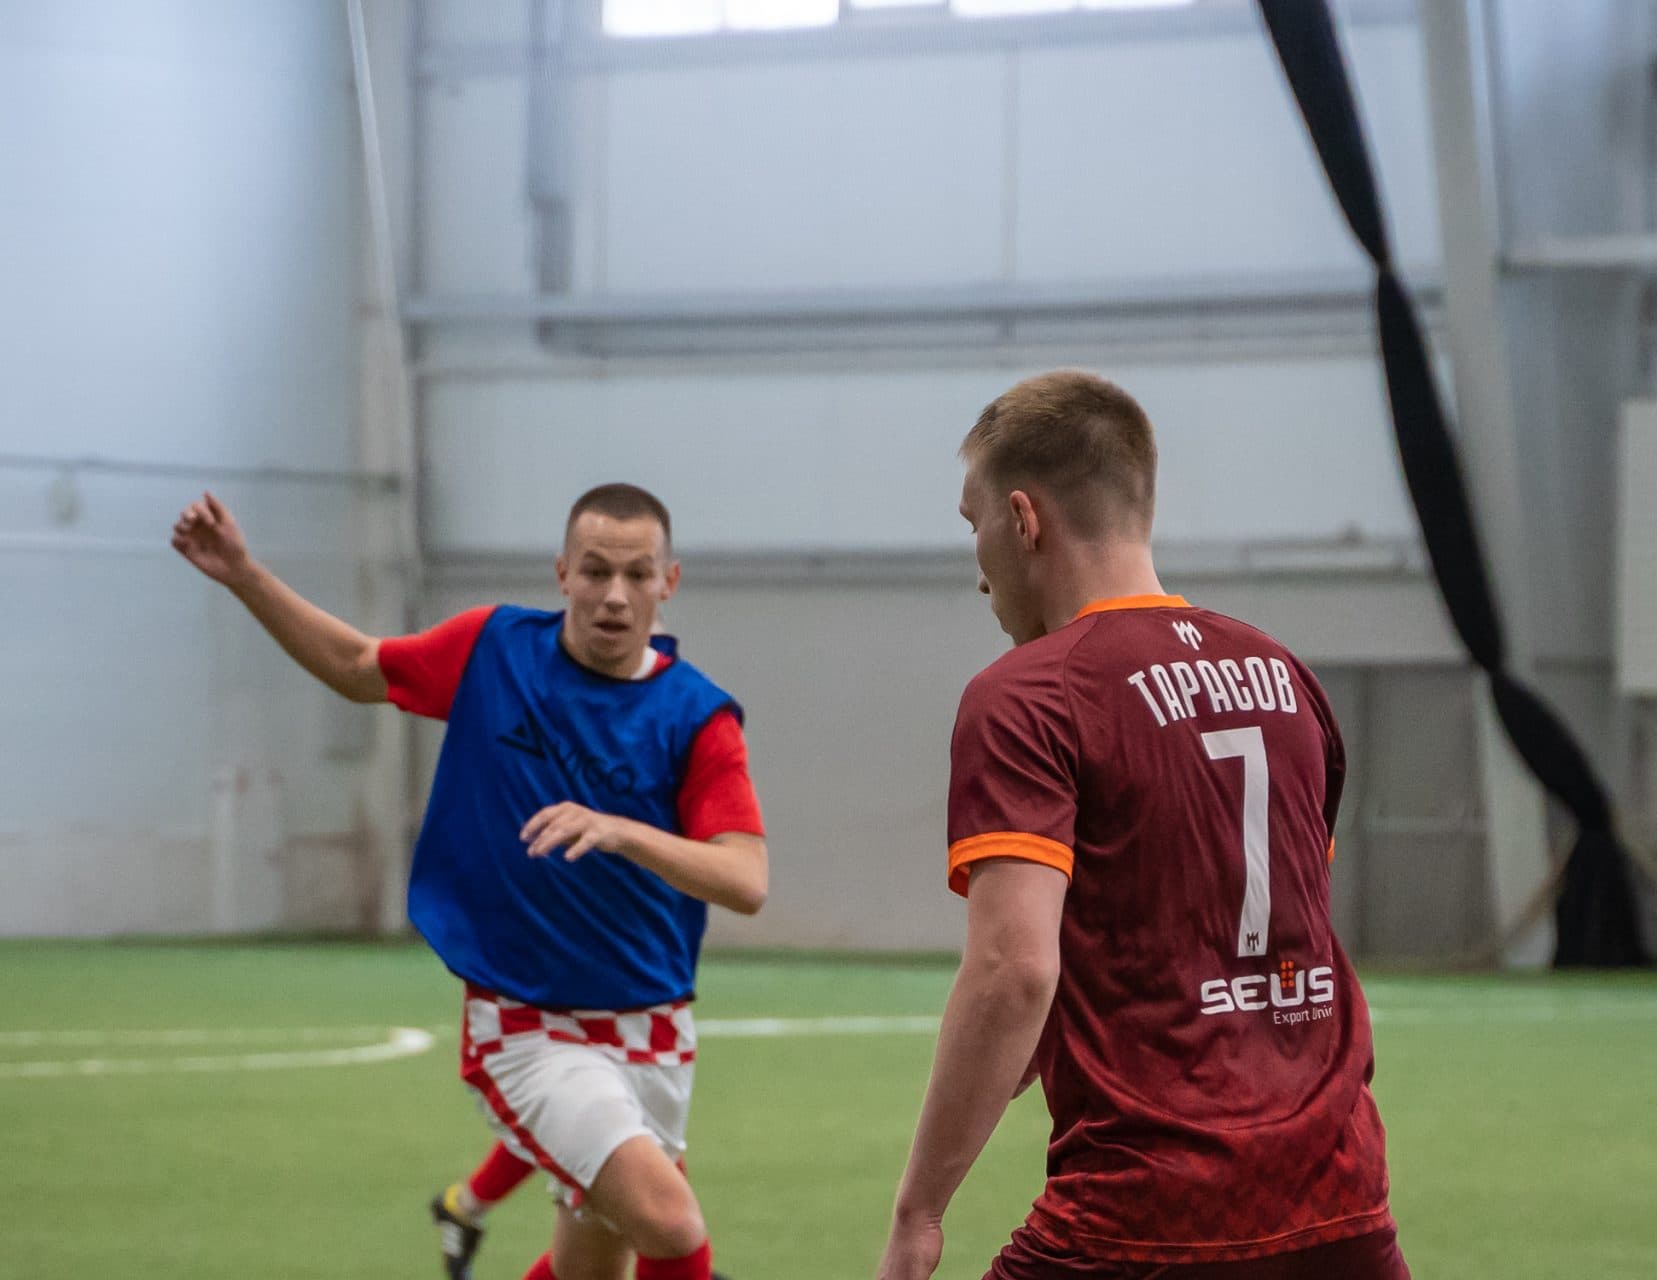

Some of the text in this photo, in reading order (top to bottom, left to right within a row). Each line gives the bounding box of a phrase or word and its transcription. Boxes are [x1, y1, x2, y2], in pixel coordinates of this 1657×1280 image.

[1128, 657, 1297, 726] ТАРАСОВ
[1202, 727, 1270, 957] 7
[1273, 1006, 1310, 1025] Export
